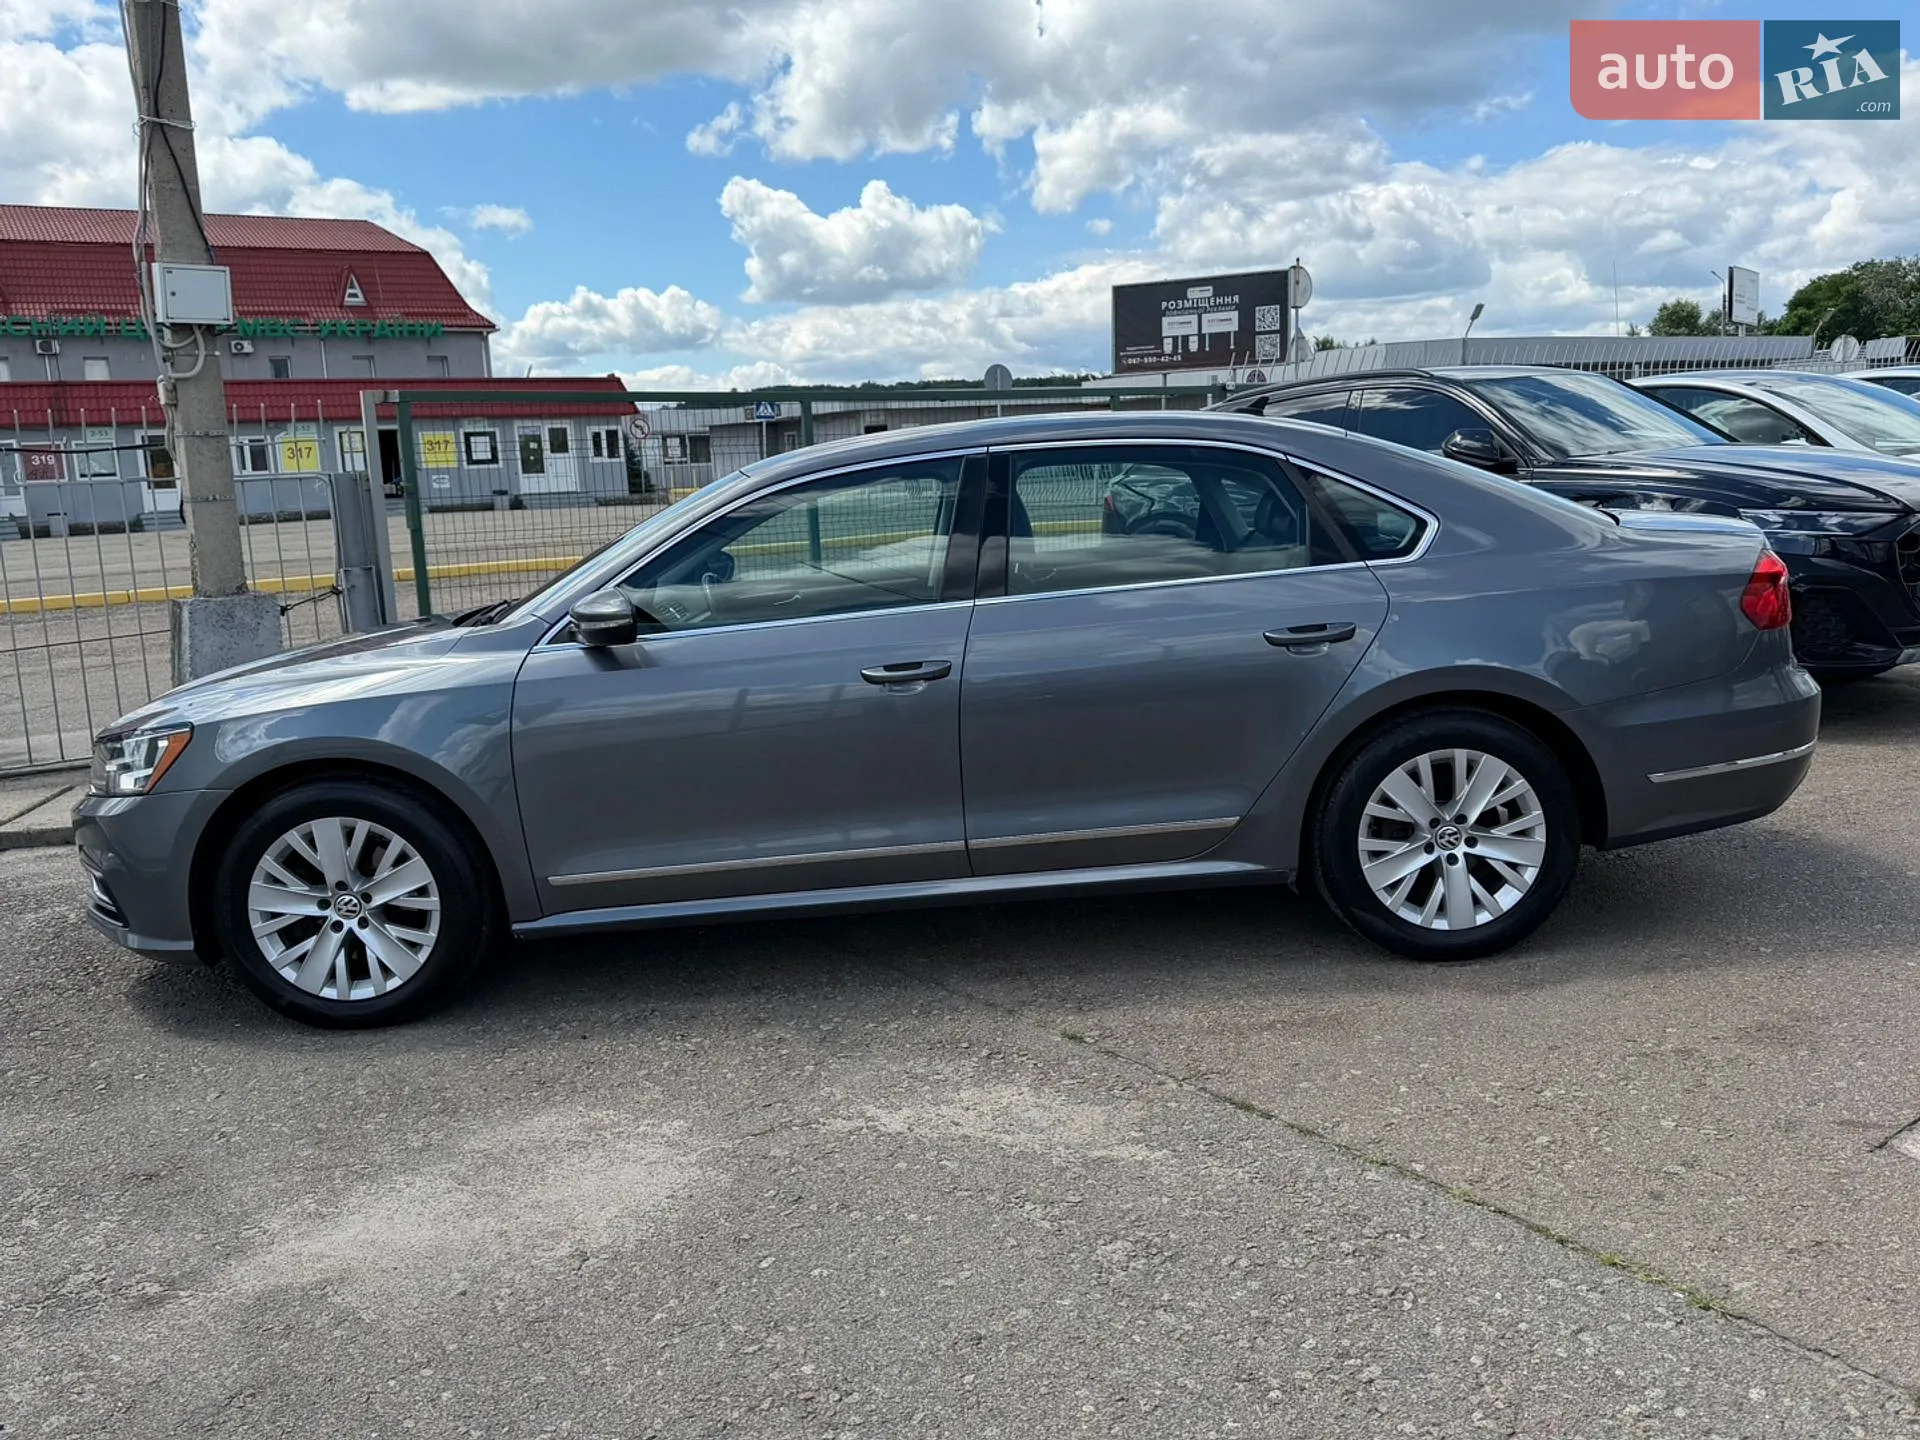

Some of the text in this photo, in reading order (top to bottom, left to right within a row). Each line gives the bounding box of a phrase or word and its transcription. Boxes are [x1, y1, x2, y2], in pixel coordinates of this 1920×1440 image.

[1161, 294, 1240, 310] РОЗМІЩЕННЯ
[237, 317, 305, 338] МВС
[317, 314, 444, 339] УКРАЇНИ
[426, 439, 450, 452] 317
[31, 454, 55, 466] 319
[286, 446, 313, 460] 317
